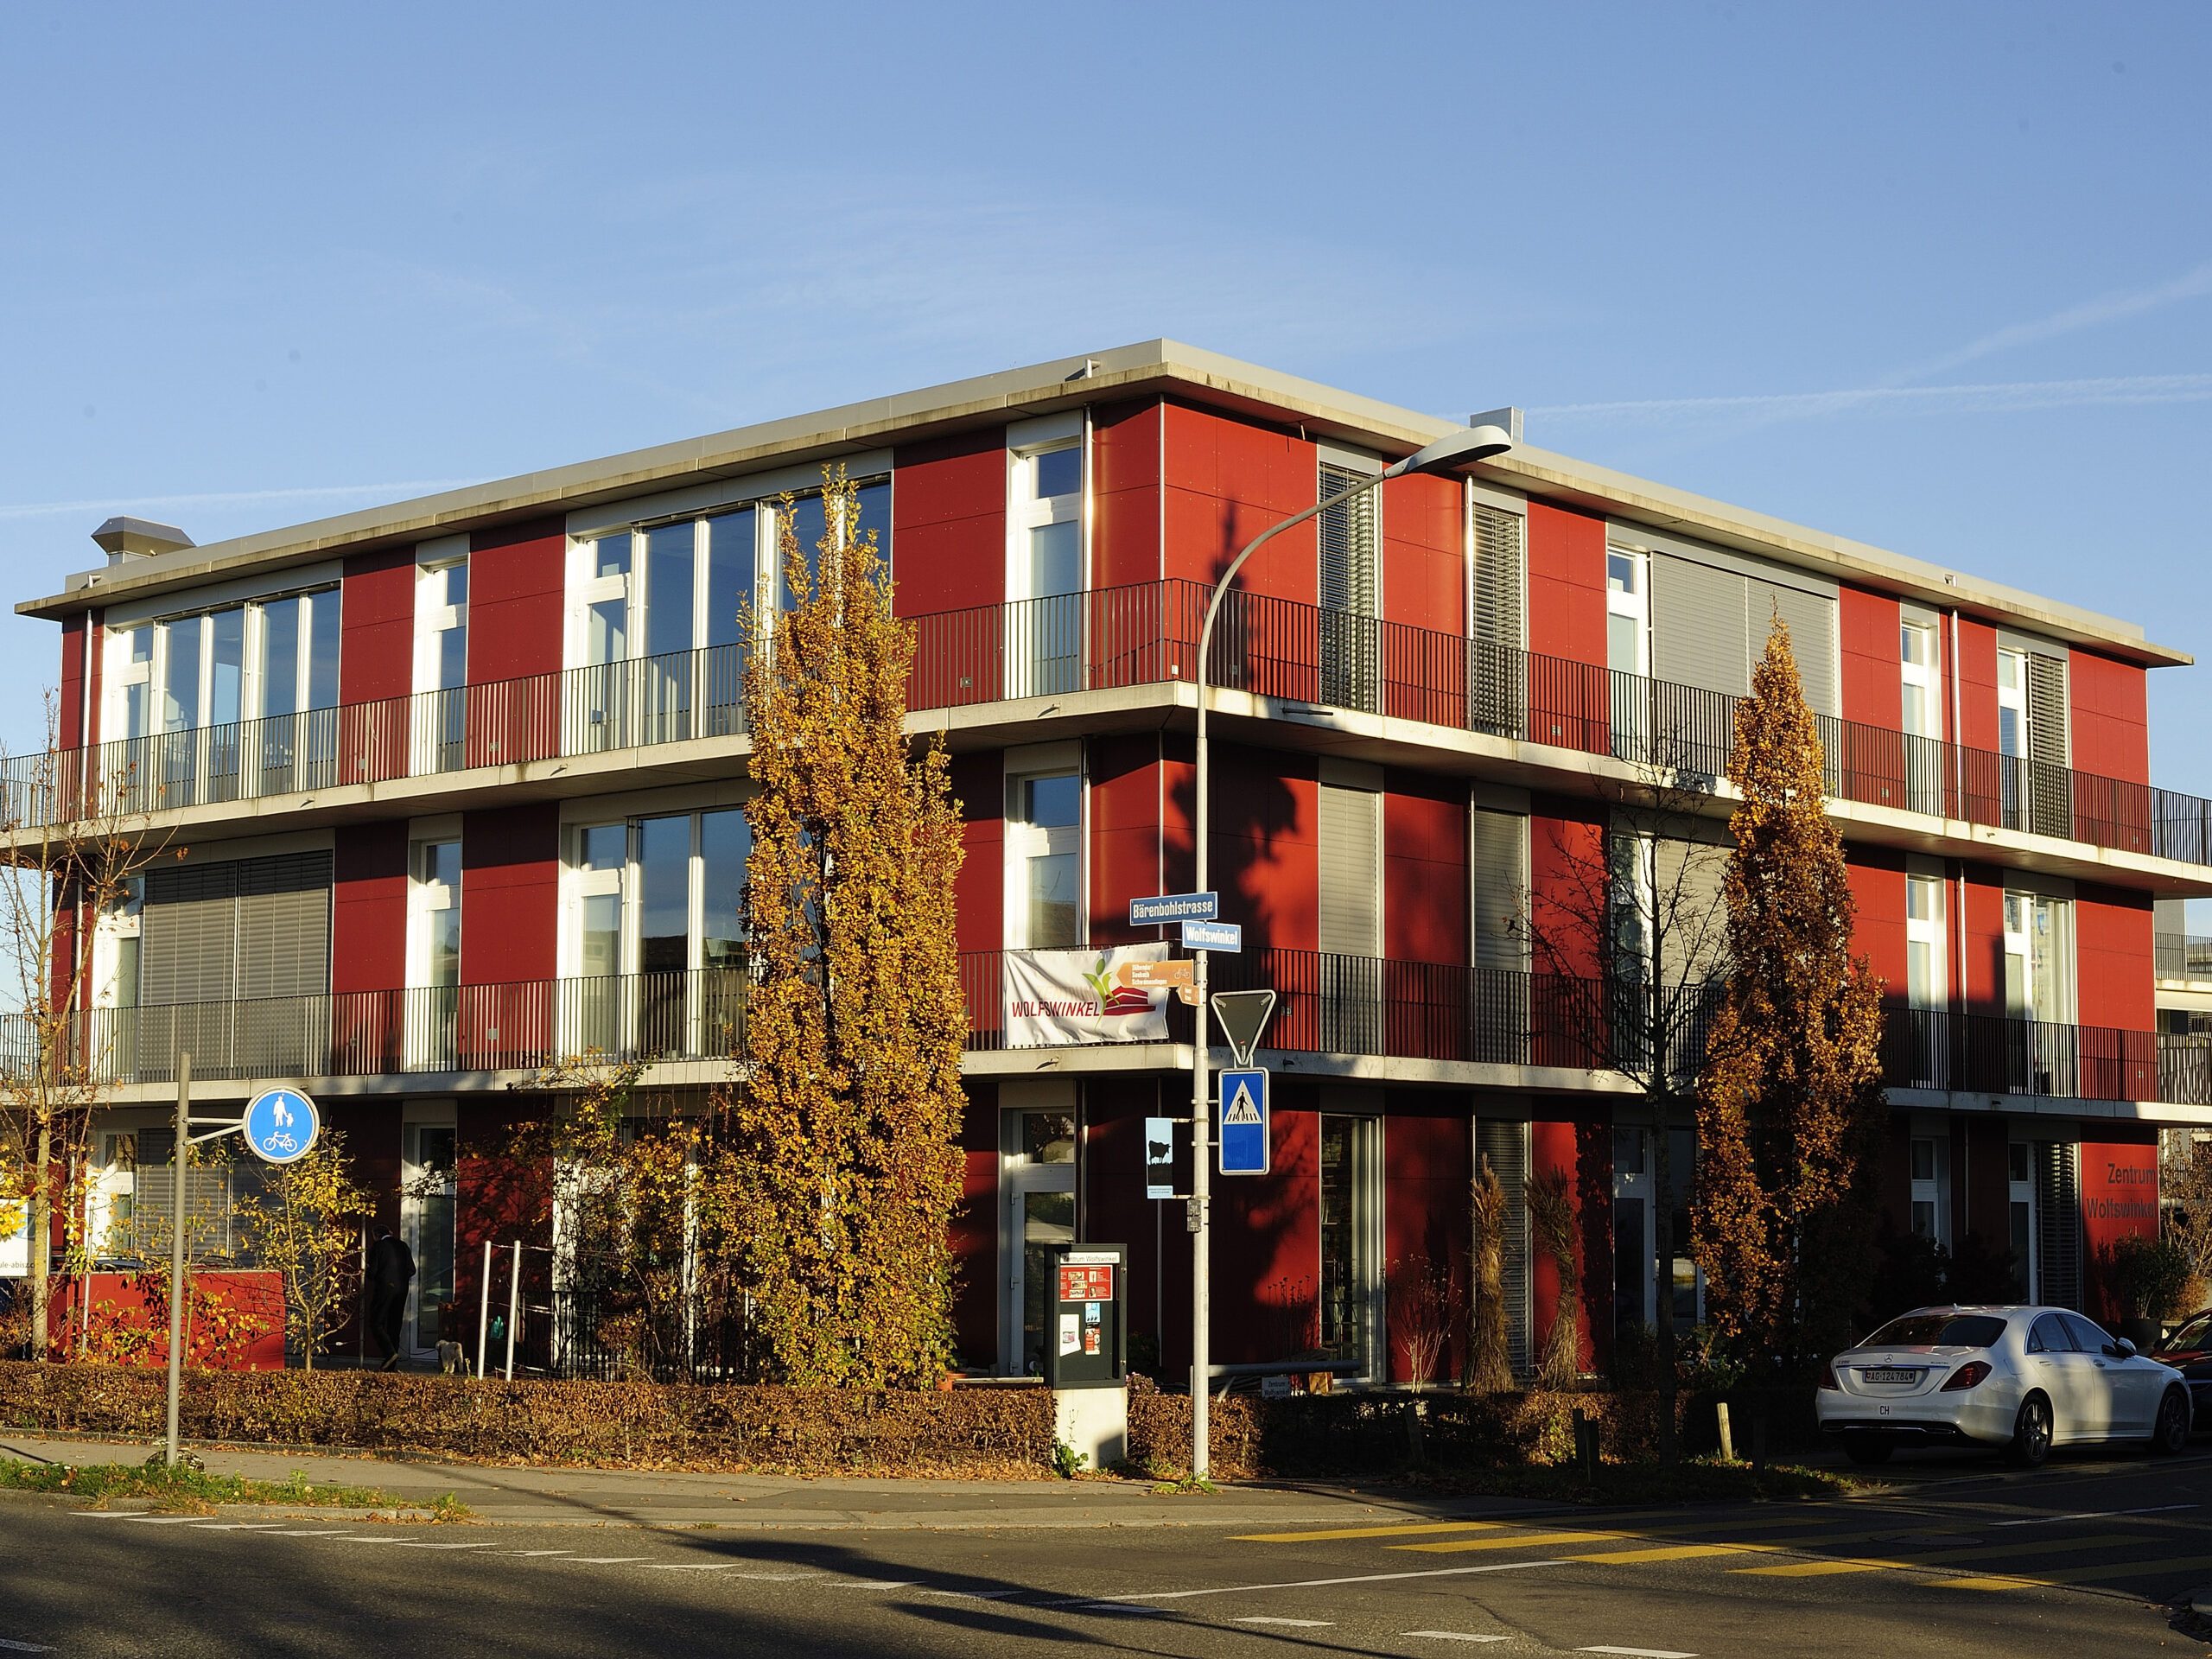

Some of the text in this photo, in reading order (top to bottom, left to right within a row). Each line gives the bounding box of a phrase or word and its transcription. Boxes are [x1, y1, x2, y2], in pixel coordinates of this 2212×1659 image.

[1133, 900, 1213, 918] Bärenbohlstrasse
[1185, 926, 1238, 945] Wolfswinkel
[1012, 1001, 1100, 1018] WOLFSWINKEL
[2107, 1163, 2156, 1185] Zentrum
[2086, 1198, 2157, 1219] Wolfswinkel
[1879, 1405, 1890, 1415] CH
